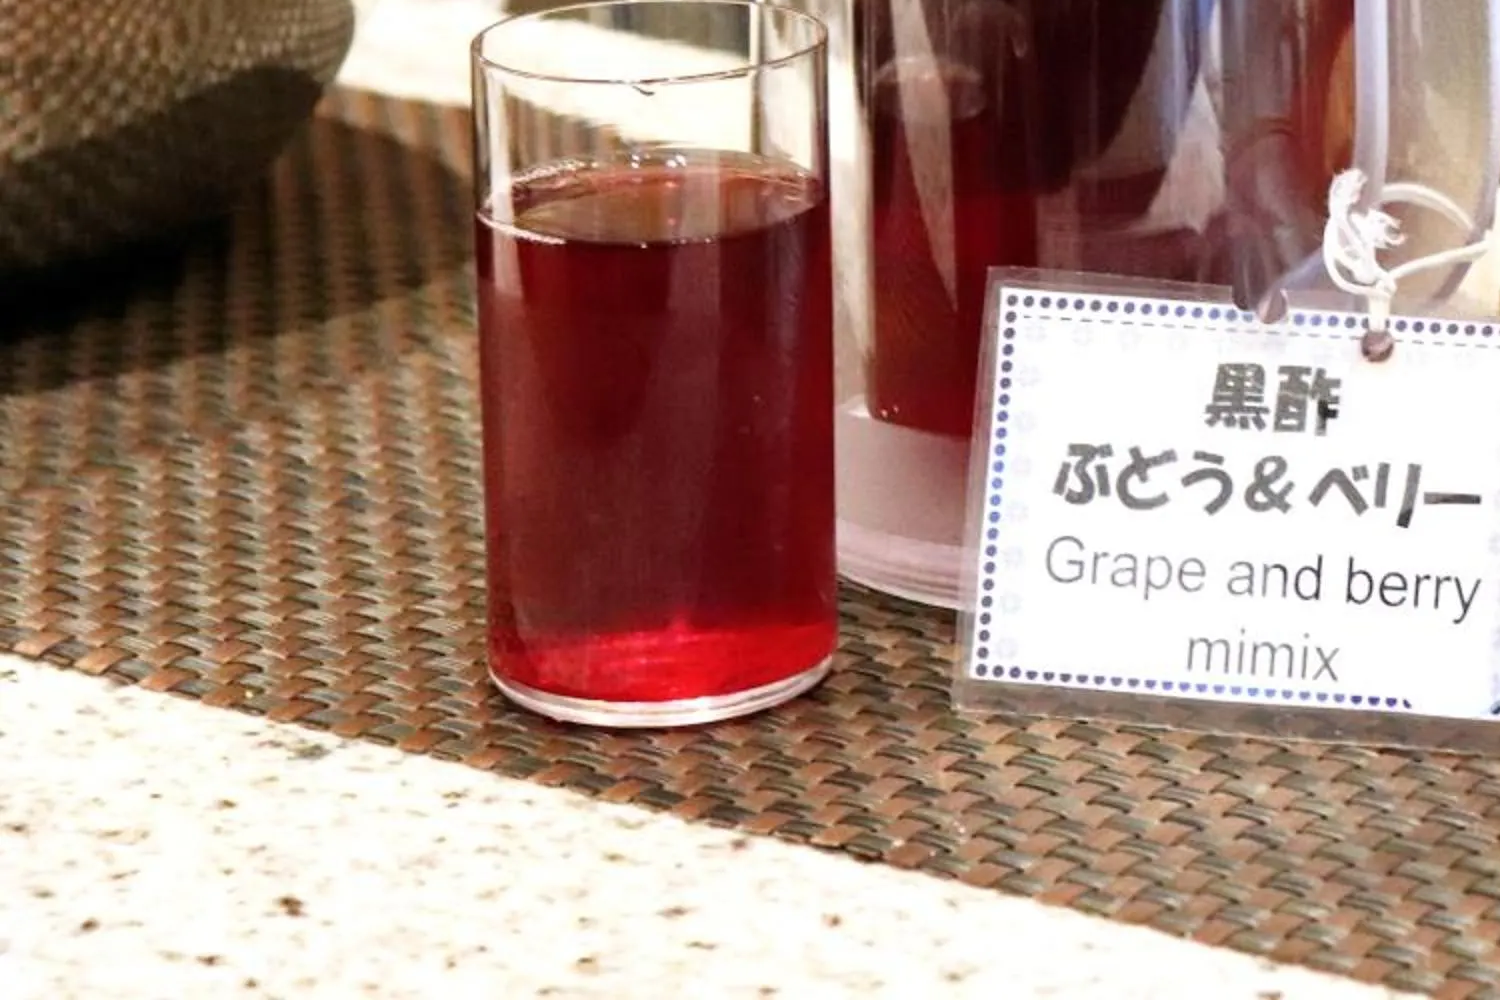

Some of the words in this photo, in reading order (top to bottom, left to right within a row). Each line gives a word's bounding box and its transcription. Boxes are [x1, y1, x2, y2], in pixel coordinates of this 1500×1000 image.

[1204, 362, 1343, 437] 黒酢
[1044, 535, 1206, 600] Grape
[1226, 554, 1324, 601] and
[1345, 556, 1482, 624] berry
[1186, 628, 1341, 682] mimix
